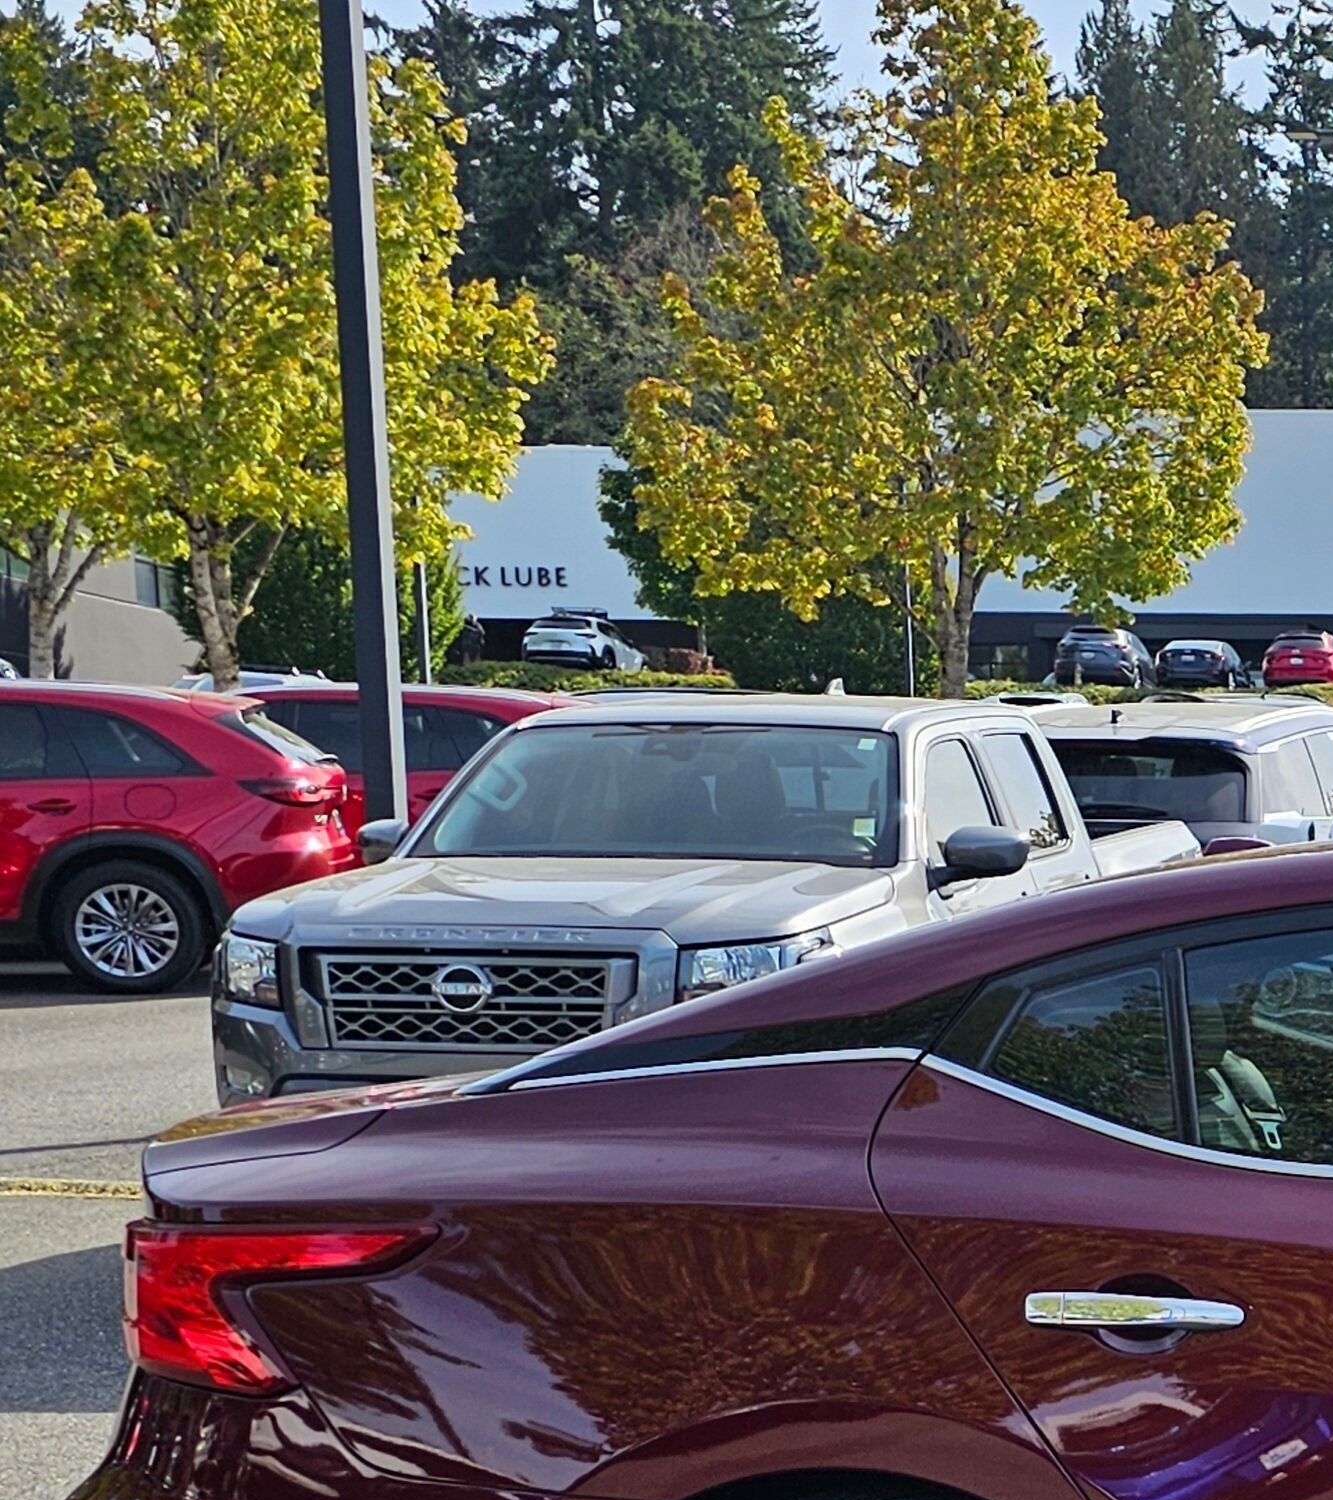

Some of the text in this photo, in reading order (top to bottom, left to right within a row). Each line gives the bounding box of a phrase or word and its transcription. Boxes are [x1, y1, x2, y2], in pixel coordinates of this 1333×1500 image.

[500, 566, 568, 587] LUBE
[347, 927, 592, 942] FRONTIER
[431, 982, 492, 995] NISSAN
